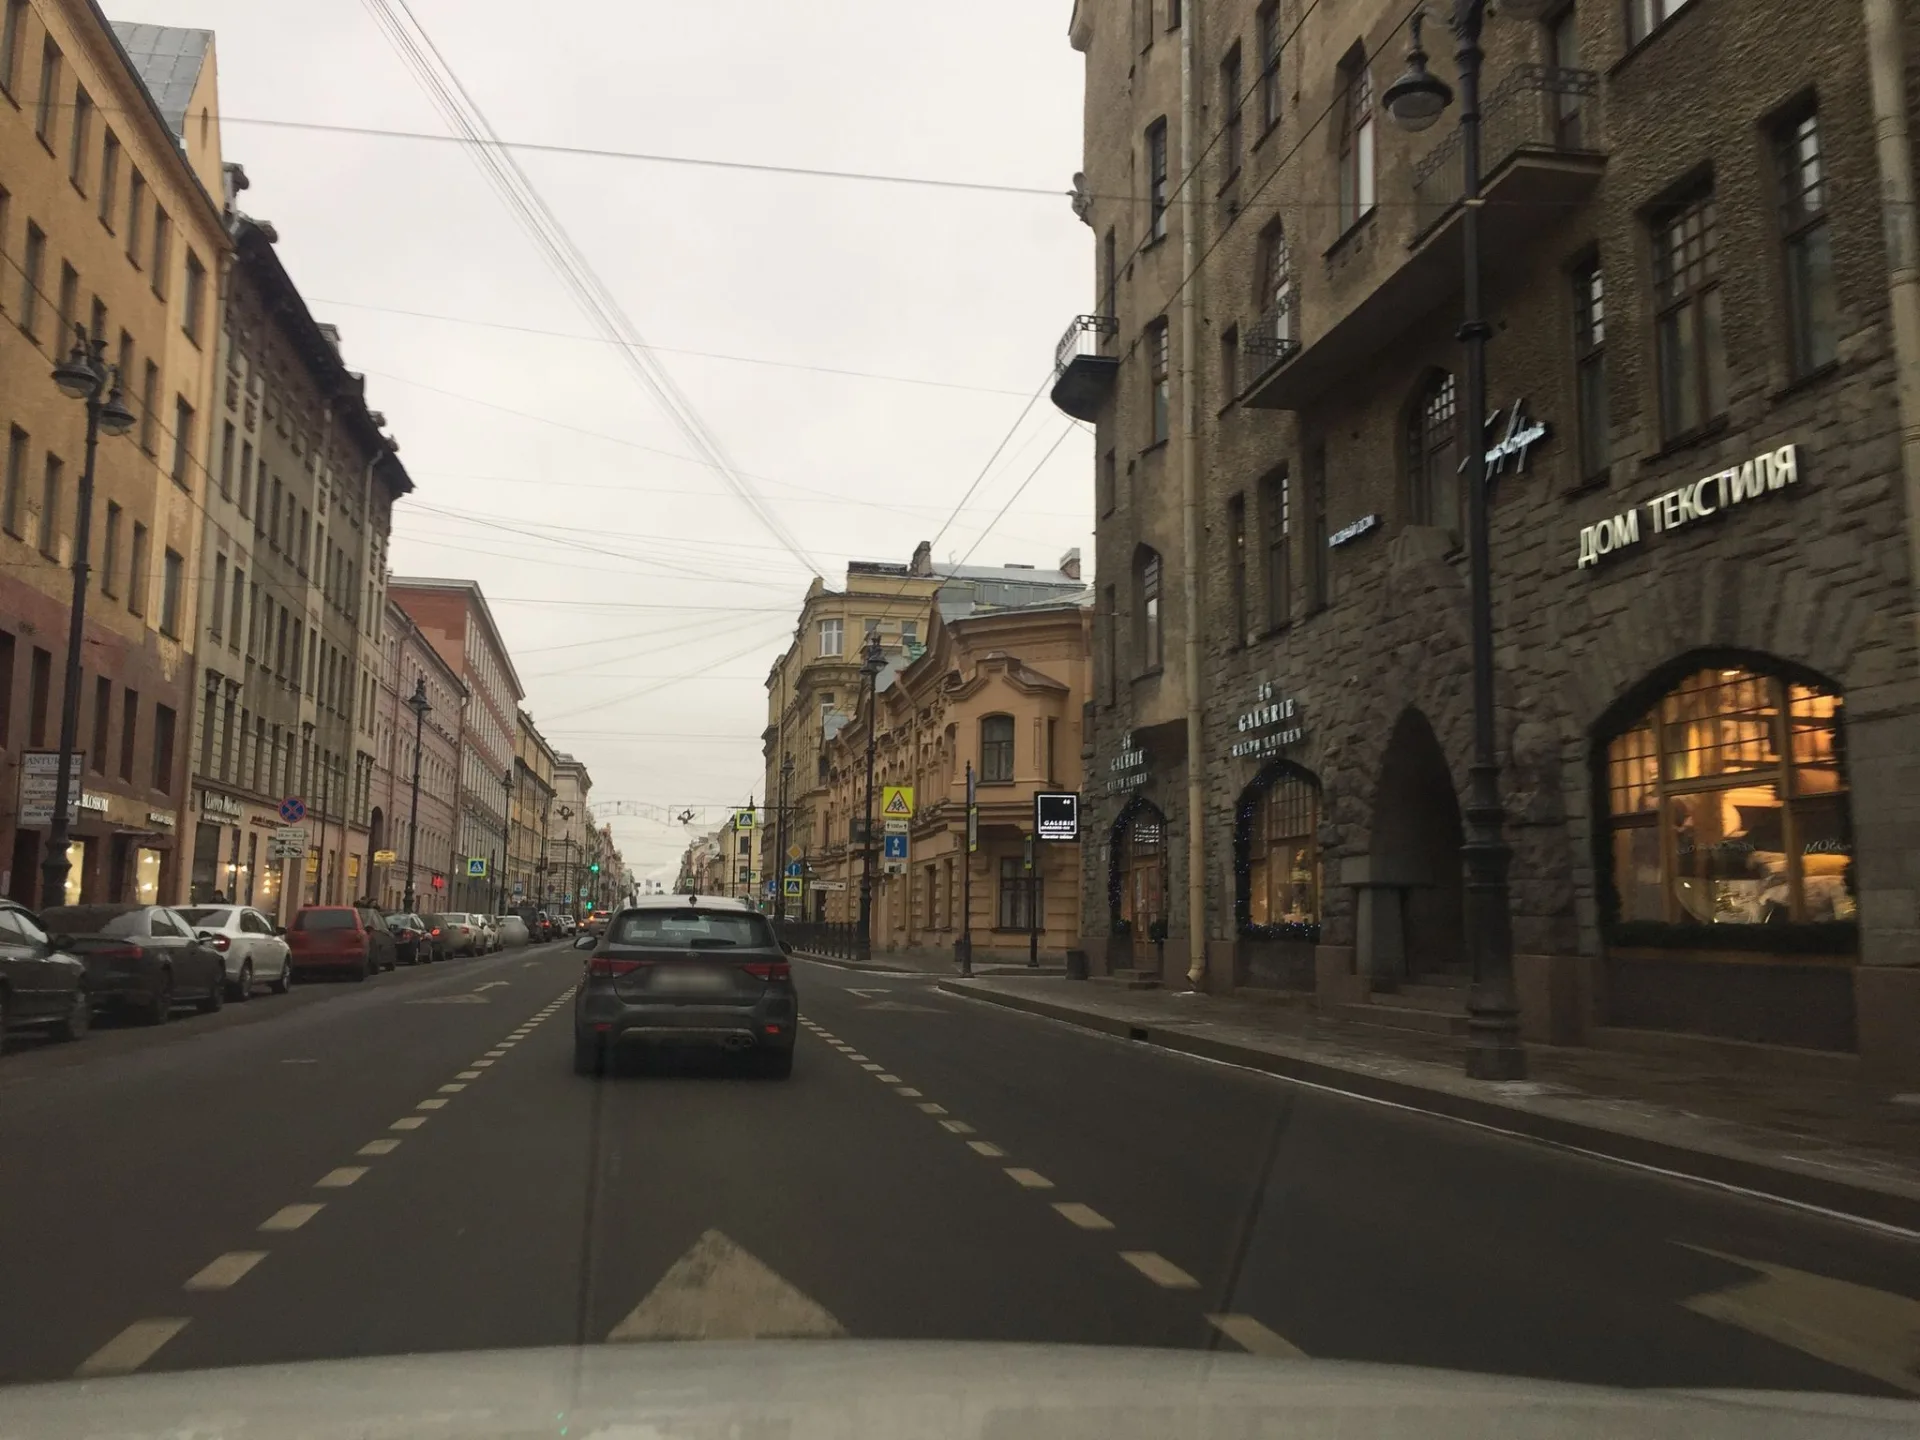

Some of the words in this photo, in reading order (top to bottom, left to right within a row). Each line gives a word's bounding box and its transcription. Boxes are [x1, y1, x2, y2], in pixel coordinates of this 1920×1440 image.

[1577, 508, 1640, 570] ДОМ
[1647, 443, 1798, 534] ТЕКСТИЛЯ
[1258, 681, 1272, 701] 46
[1238, 698, 1294, 732] GALERIE
[1111, 750, 1143, 771] GALERIE
